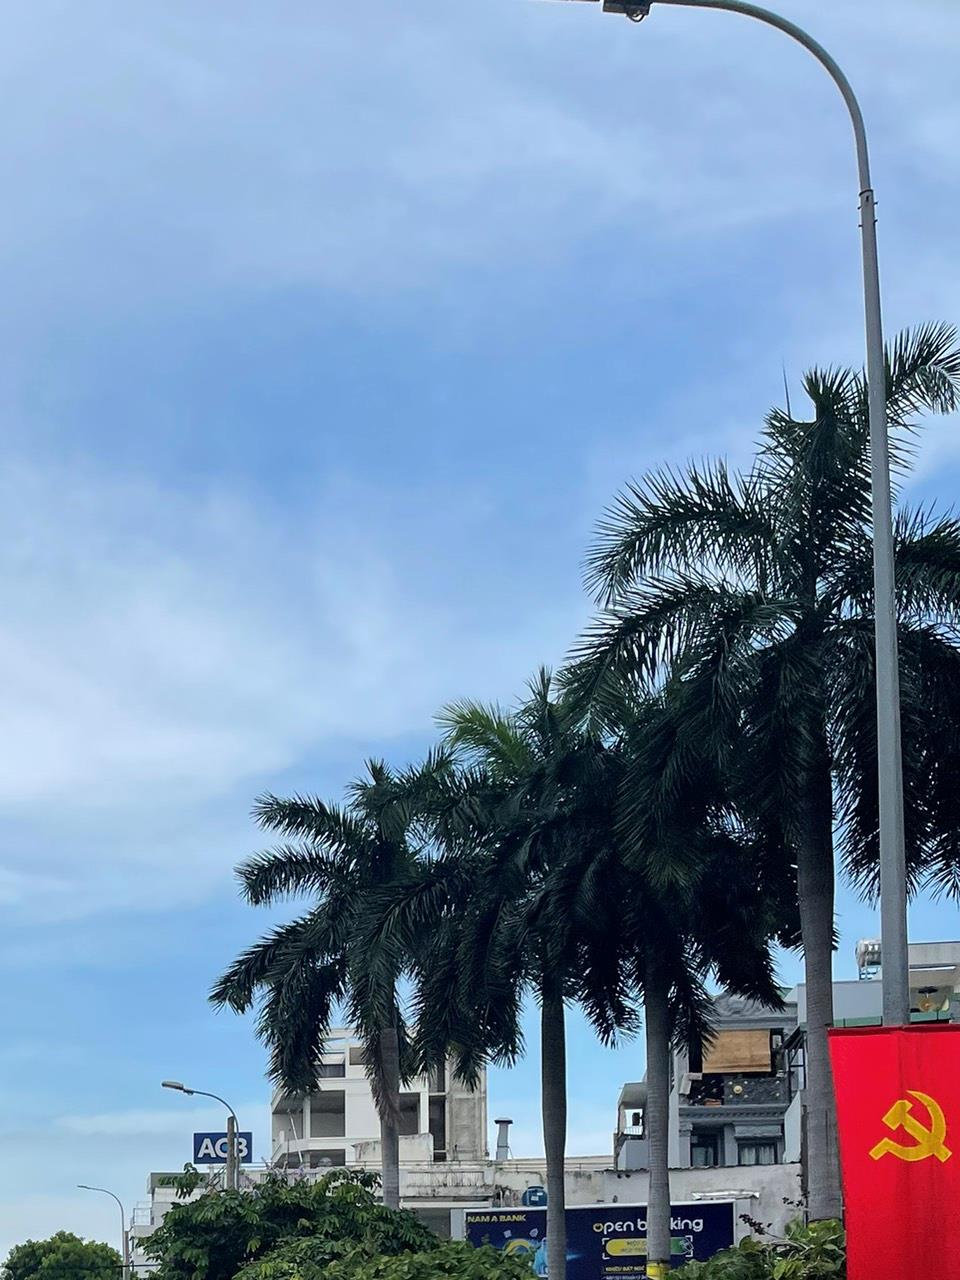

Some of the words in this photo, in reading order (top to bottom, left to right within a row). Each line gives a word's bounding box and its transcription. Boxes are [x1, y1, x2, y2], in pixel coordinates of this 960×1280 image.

[197, 1137, 249, 1158] ACB
[467, 1215, 490, 1223] NAM
[500, 1214, 527, 1222] BANK
[592, 1221, 635, 1235] open
[637, 1217, 704, 1232] bking
